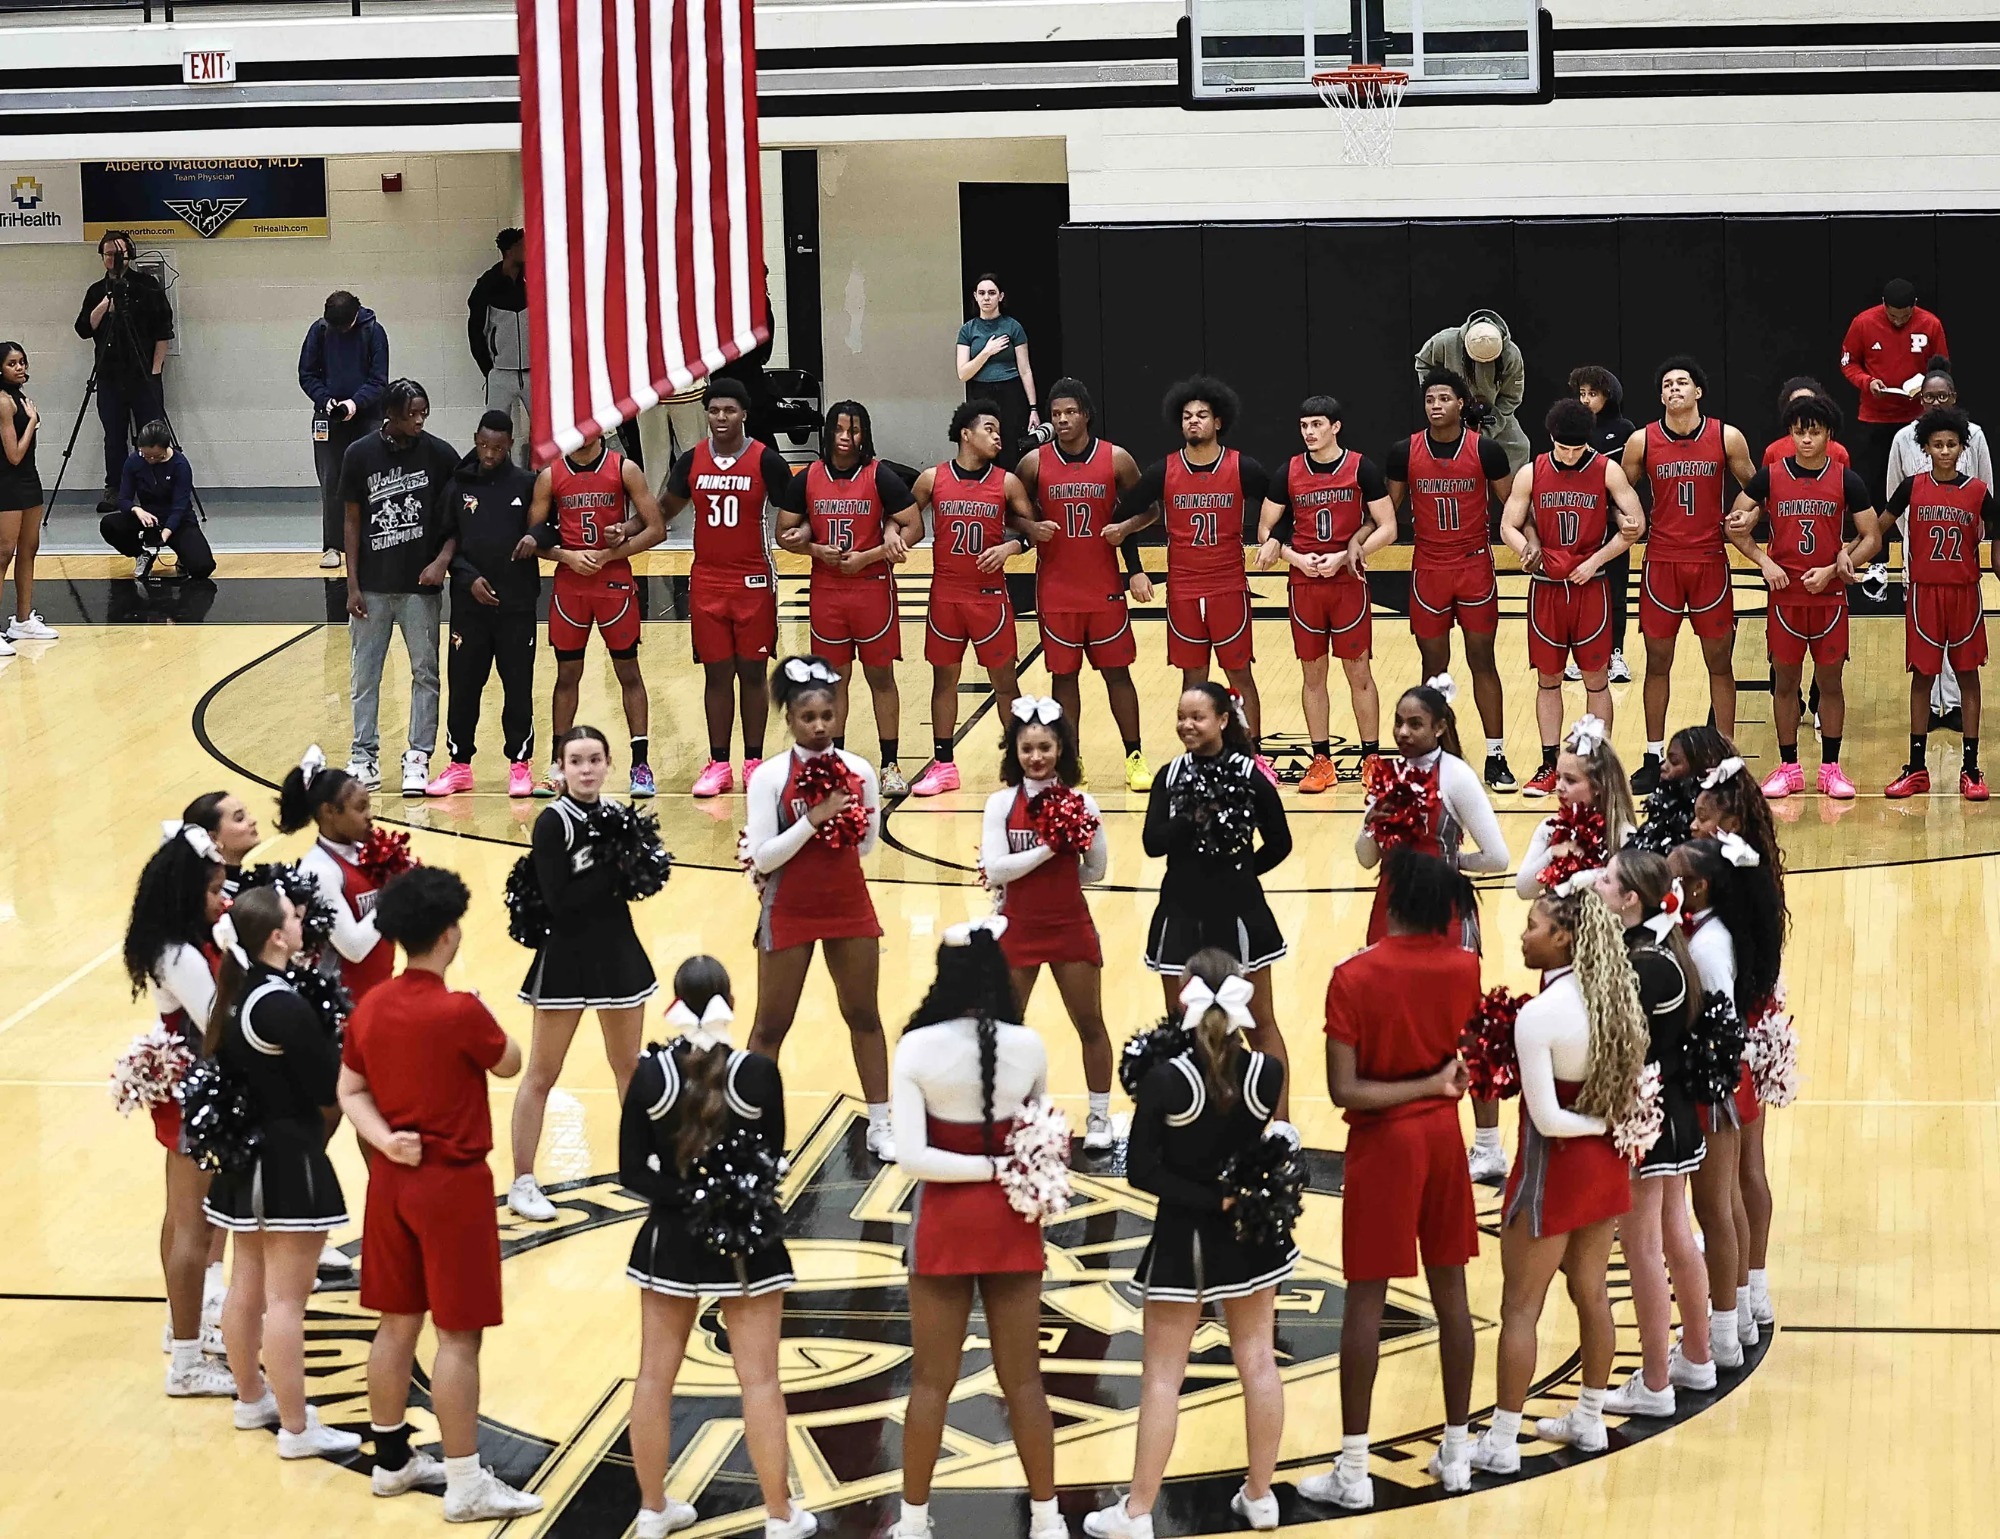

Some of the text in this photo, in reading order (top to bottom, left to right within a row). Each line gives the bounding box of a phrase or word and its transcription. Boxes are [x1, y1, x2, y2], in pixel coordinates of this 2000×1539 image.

[191, 53, 225, 79] EXIT
[105, 157, 303, 171] Alberto Maldonado, M.D.
[174, 173, 235, 182] Team Physician
[0, 211, 61, 227] TriHealth
[1910, 333, 1928, 353] P
[1656, 461, 1718, 479] PRINCETON
[695, 474, 751, 492] PRINCETON
[1048, 483, 1106, 499] PRINCETON
[1416, 478, 1476, 494] PRINCETON
[561, 491, 616, 510] PRINCETON
[1173, 493, 1235, 509] PRINCETON
[1294, 488, 1354, 505] PRINCETON
[1539, 491, 1599, 510] PRINCETON
[1678, 481, 1695, 516] 4
[707, 494, 739, 528] 30
[814, 500, 871, 515] PRINCETON
[939, 500, 999, 518] PRINCETON
[1434, 497, 1460, 531] 11
[1777, 499, 1838, 518] PRINCETON
[1917, 505, 1975, 526] PRINCETON
[581, 511, 598, 546] 5
[1063, 502, 1093, 538] 12
[1190, 513, 1217, 547] 21
[1315, 508, 1333, 542] 0
[1557, 511, 1580, 546] 10
[828, 519, 854, 551] 15
[950, 521, 984, 556] 20
[1798, 520, 1816, 555] 3
[1929, 526, 1963, 562] 22
